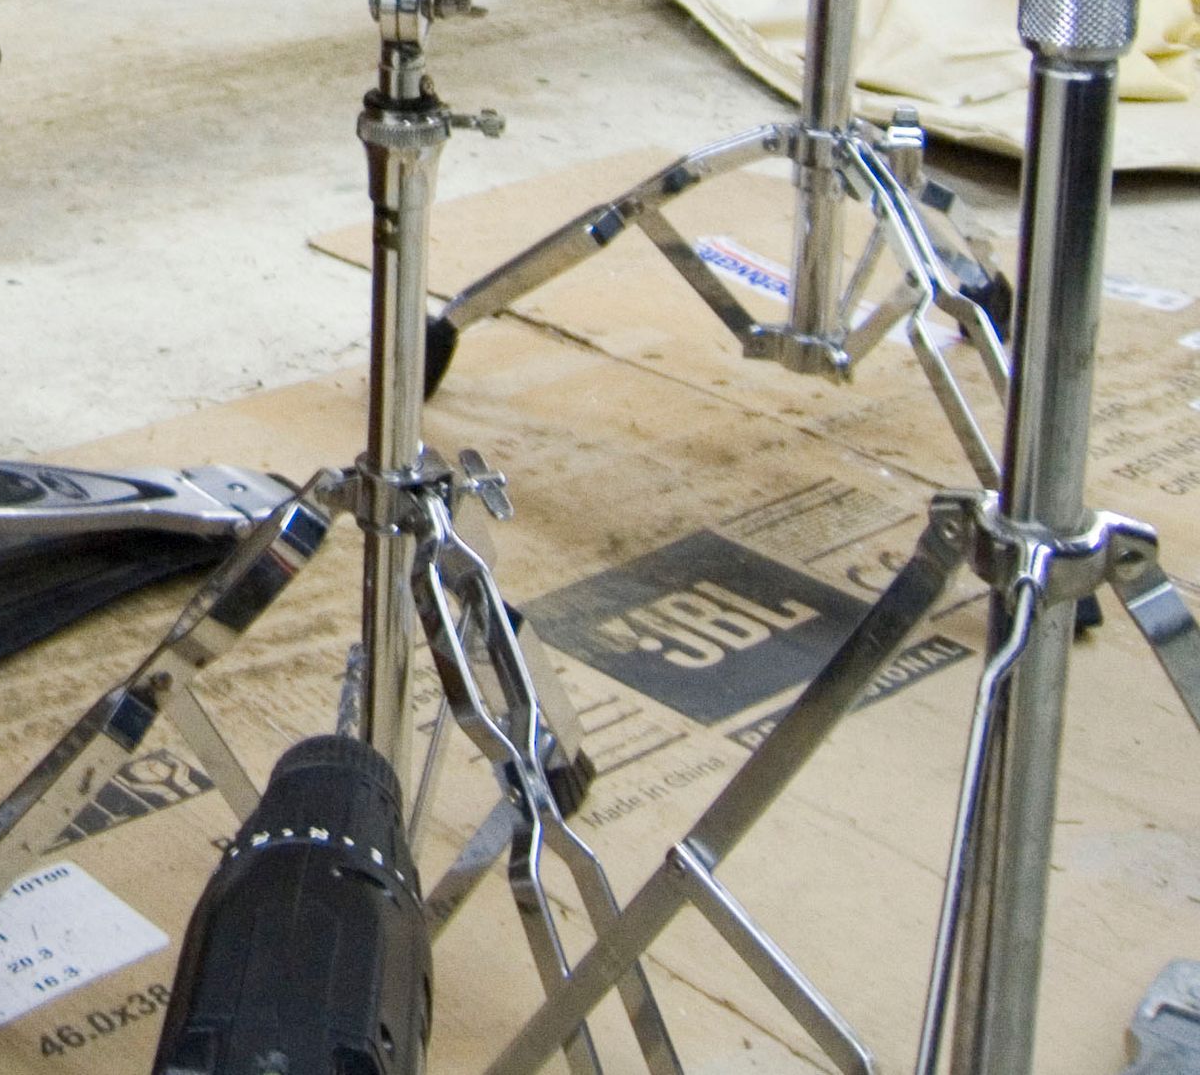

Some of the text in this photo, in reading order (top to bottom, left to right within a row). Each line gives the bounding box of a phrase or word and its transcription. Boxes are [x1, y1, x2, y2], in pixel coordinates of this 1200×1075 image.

[627, 580, 822, 669] JBL
[580, 755, 726, 829] Made in China
